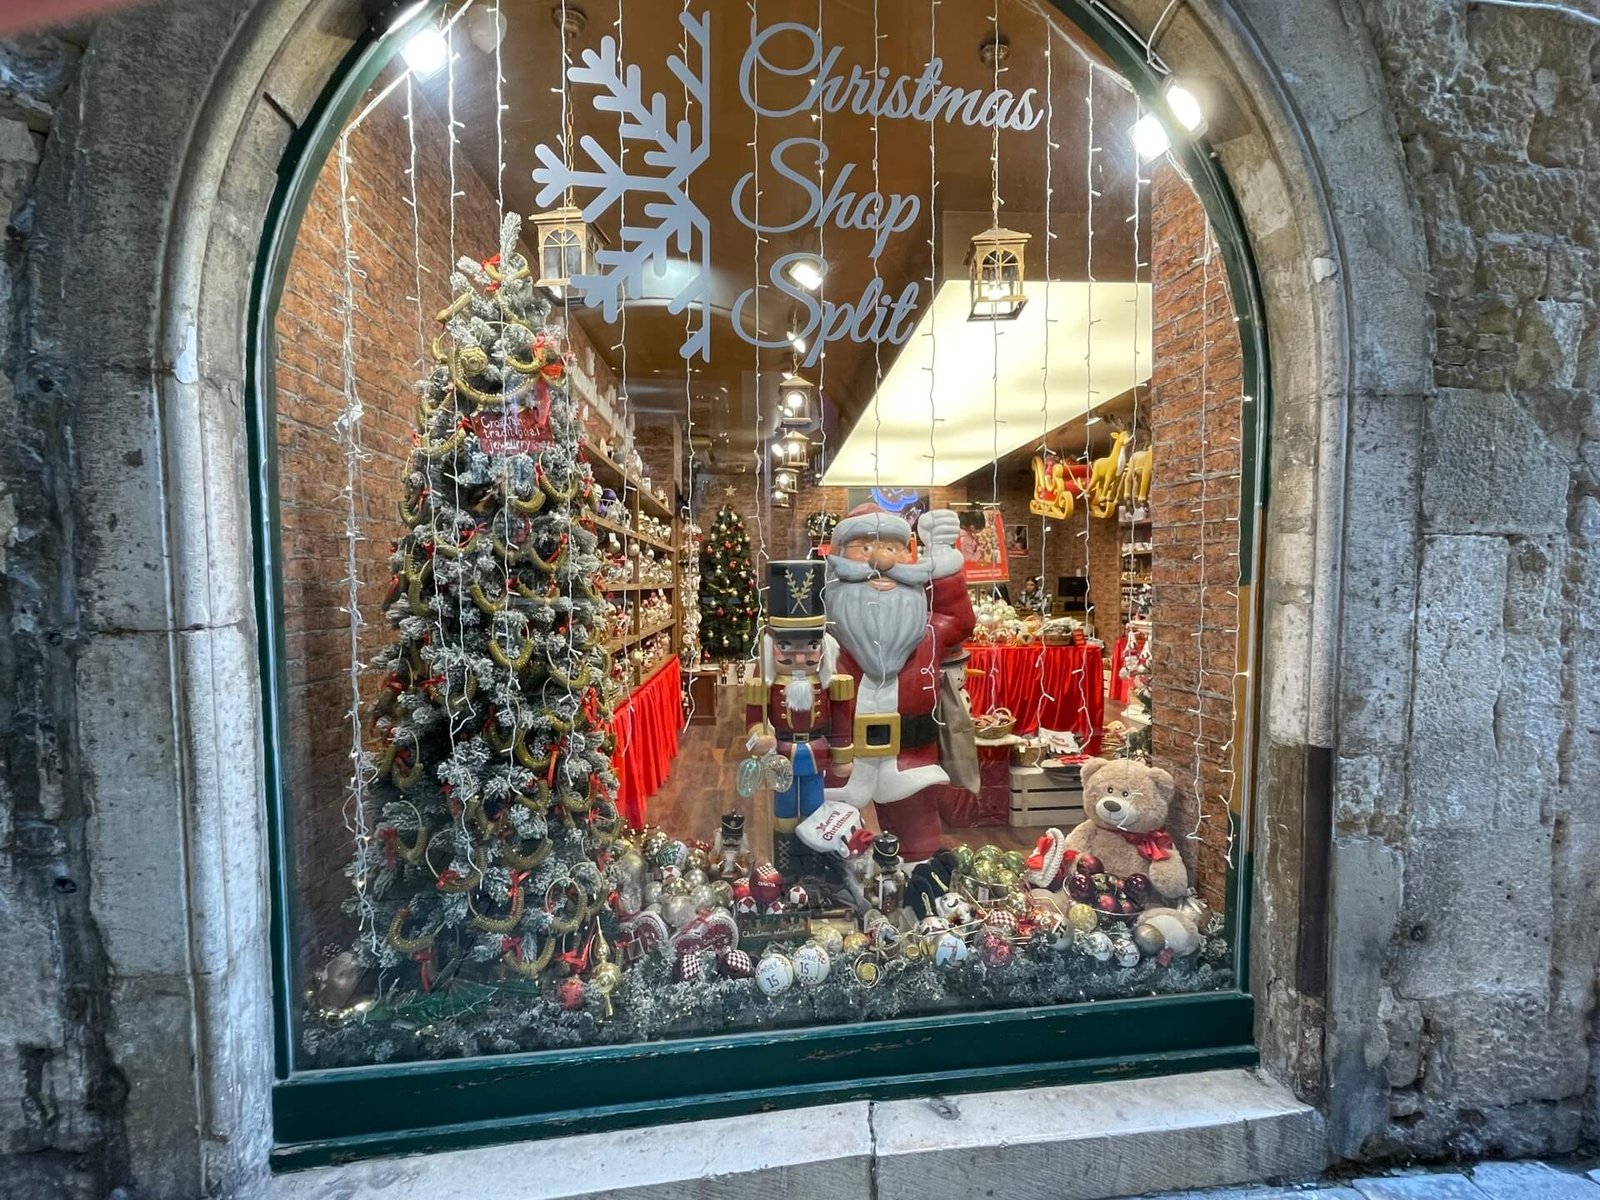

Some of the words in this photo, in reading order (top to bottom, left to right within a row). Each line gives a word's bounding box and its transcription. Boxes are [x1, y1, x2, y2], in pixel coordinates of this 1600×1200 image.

[739, 18, 1044, 131] Christmas
[731, 137, 921, 258] Shop
[731, 252, 920, 367] Split
[483, 427, 540, 439] traditional
[489, 440, 531, 454] jewellery
[816, 810, 840, 831] Merry
[823, 811, 853, 841] Christmas
